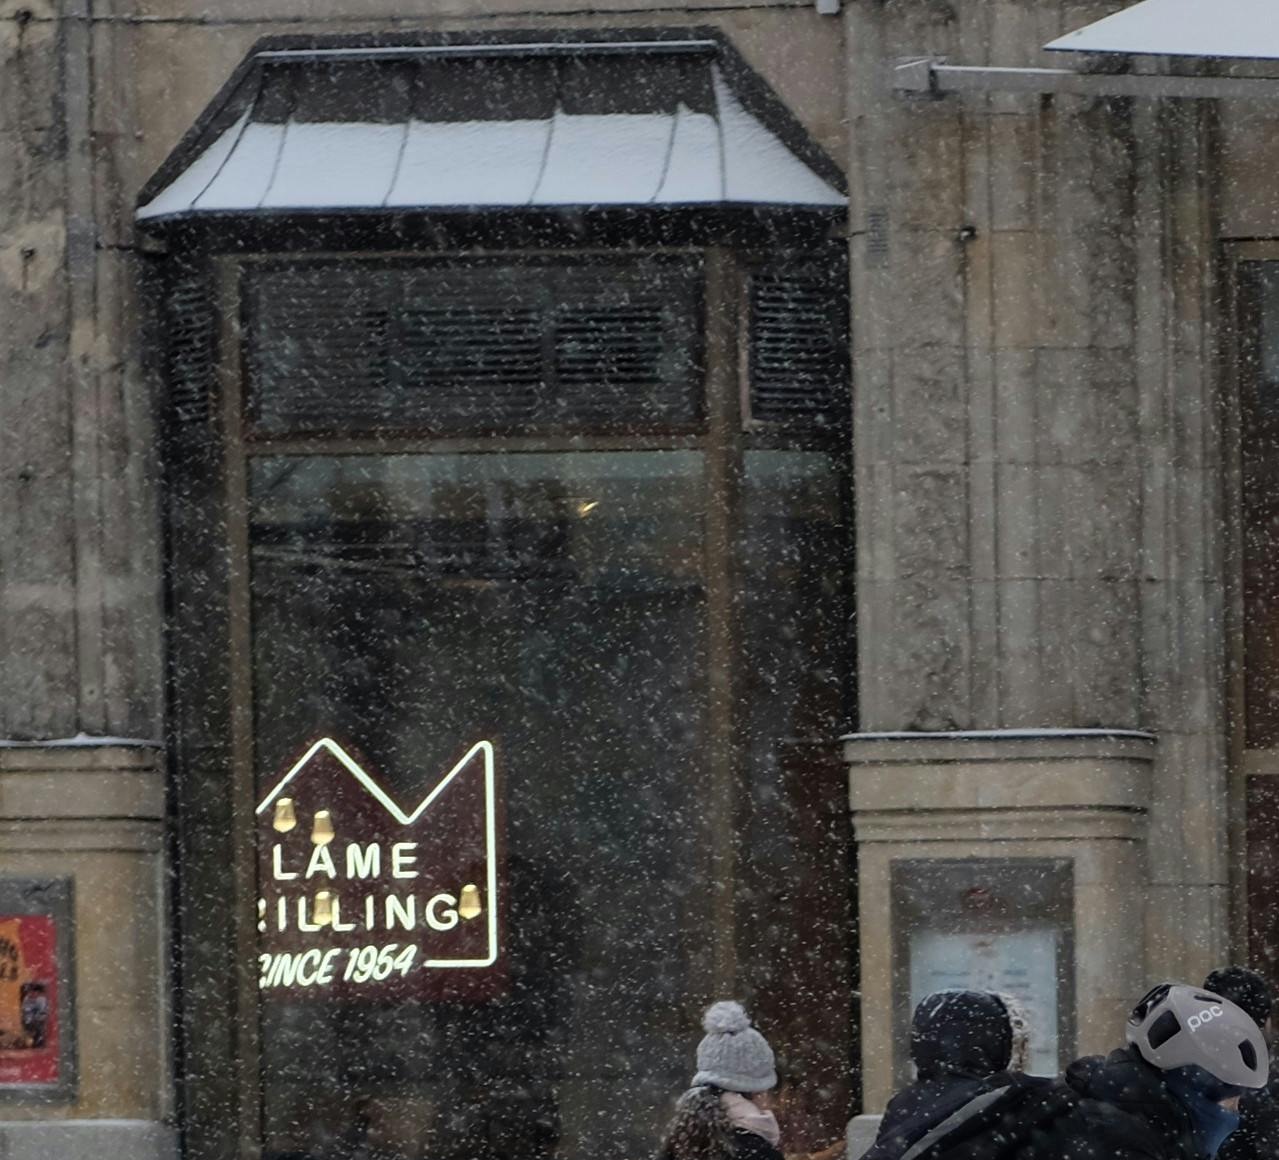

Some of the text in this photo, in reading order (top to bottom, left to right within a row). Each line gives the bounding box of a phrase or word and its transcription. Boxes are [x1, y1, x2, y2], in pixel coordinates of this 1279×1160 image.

[272, 842, 420, 881] LAME
[258, 893, 459, 932] ILLING
[343, 943, 418, 983] 1954
